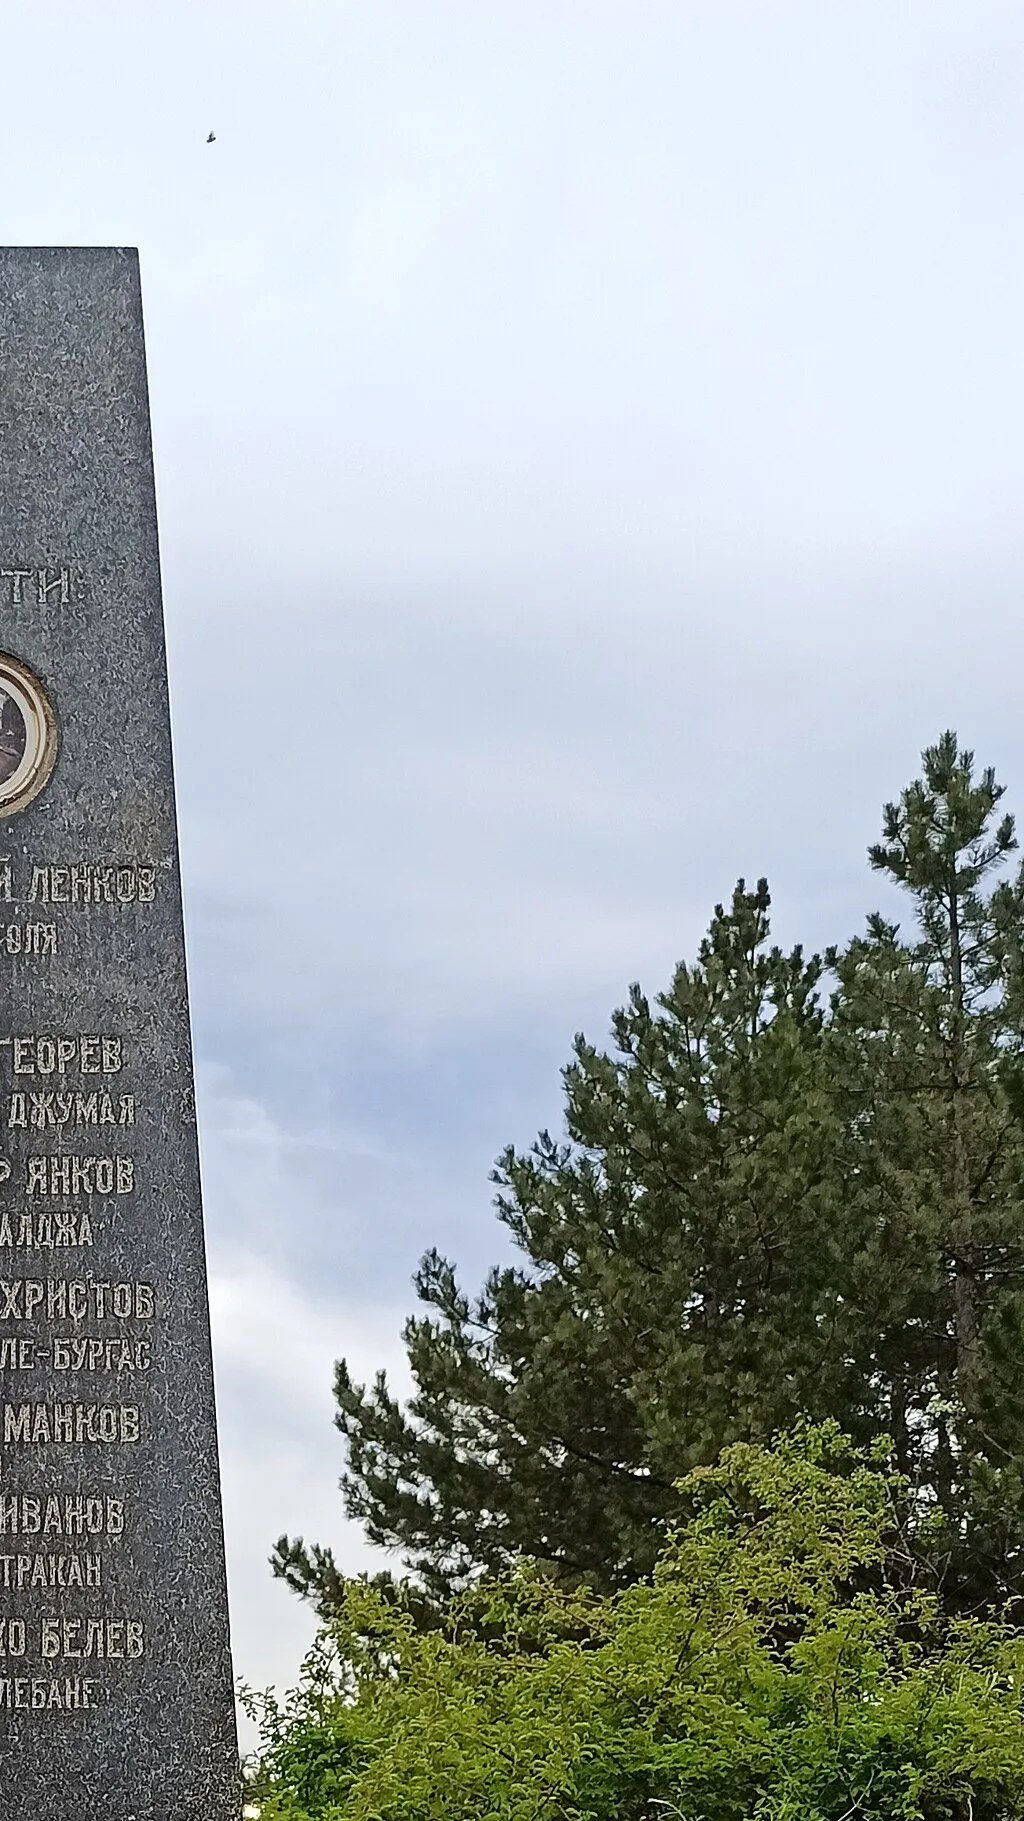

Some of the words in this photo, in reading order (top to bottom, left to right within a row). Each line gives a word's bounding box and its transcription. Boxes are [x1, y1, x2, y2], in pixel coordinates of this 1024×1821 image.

[27, 864, 157, 903] ЛЕНКОВ
[8, 1092, 137, 1129] ДЖУМАЯ
[26, 1155, 135, 1195] ЯНКОВ
[0, 1278, 156, 1320] ХРИСТОВ
[4, 1402, 141, 1443] МАНКОВ
[40, 1617, 145, 1658] БЕЛЕВ
